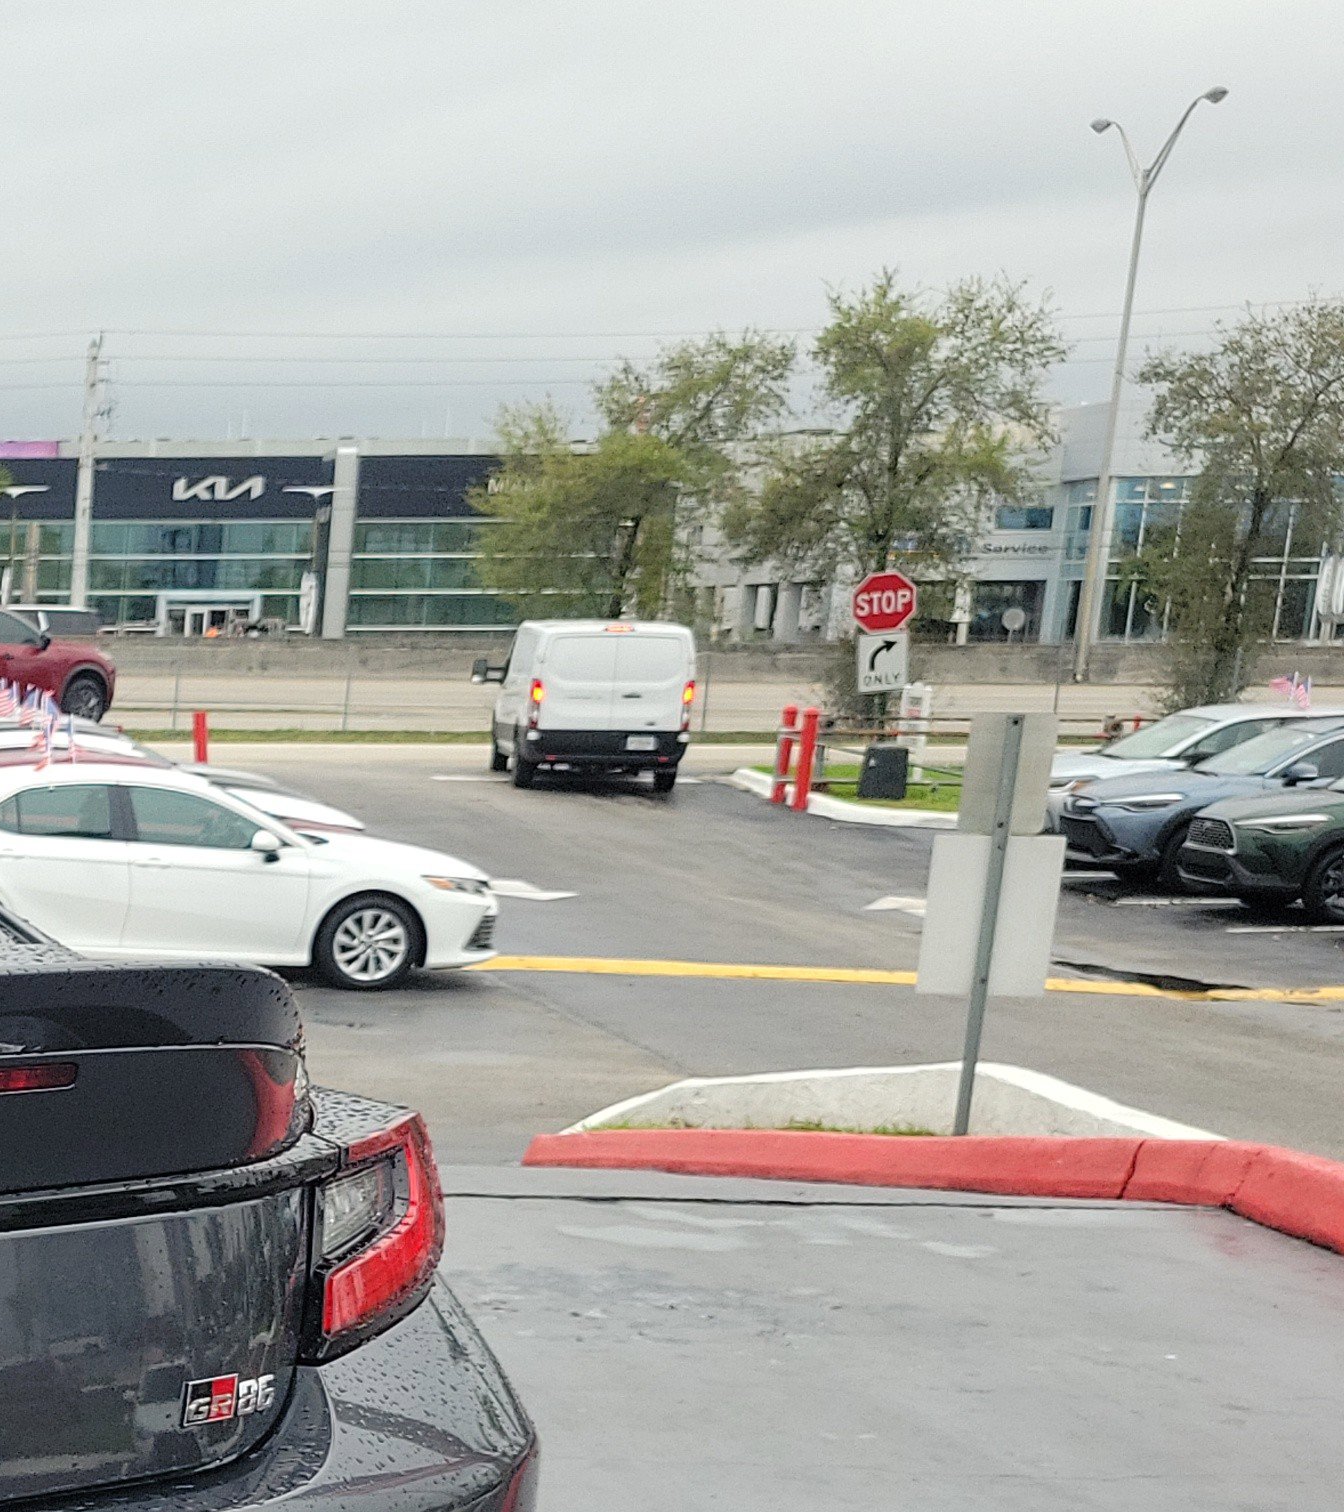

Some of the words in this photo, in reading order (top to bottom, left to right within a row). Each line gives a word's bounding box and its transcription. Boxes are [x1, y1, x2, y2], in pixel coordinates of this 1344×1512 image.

[172, 475, 264, 501] KIA
[855, 588, 912, 617] STOP
[863, 672, 901, 688] ONLY
